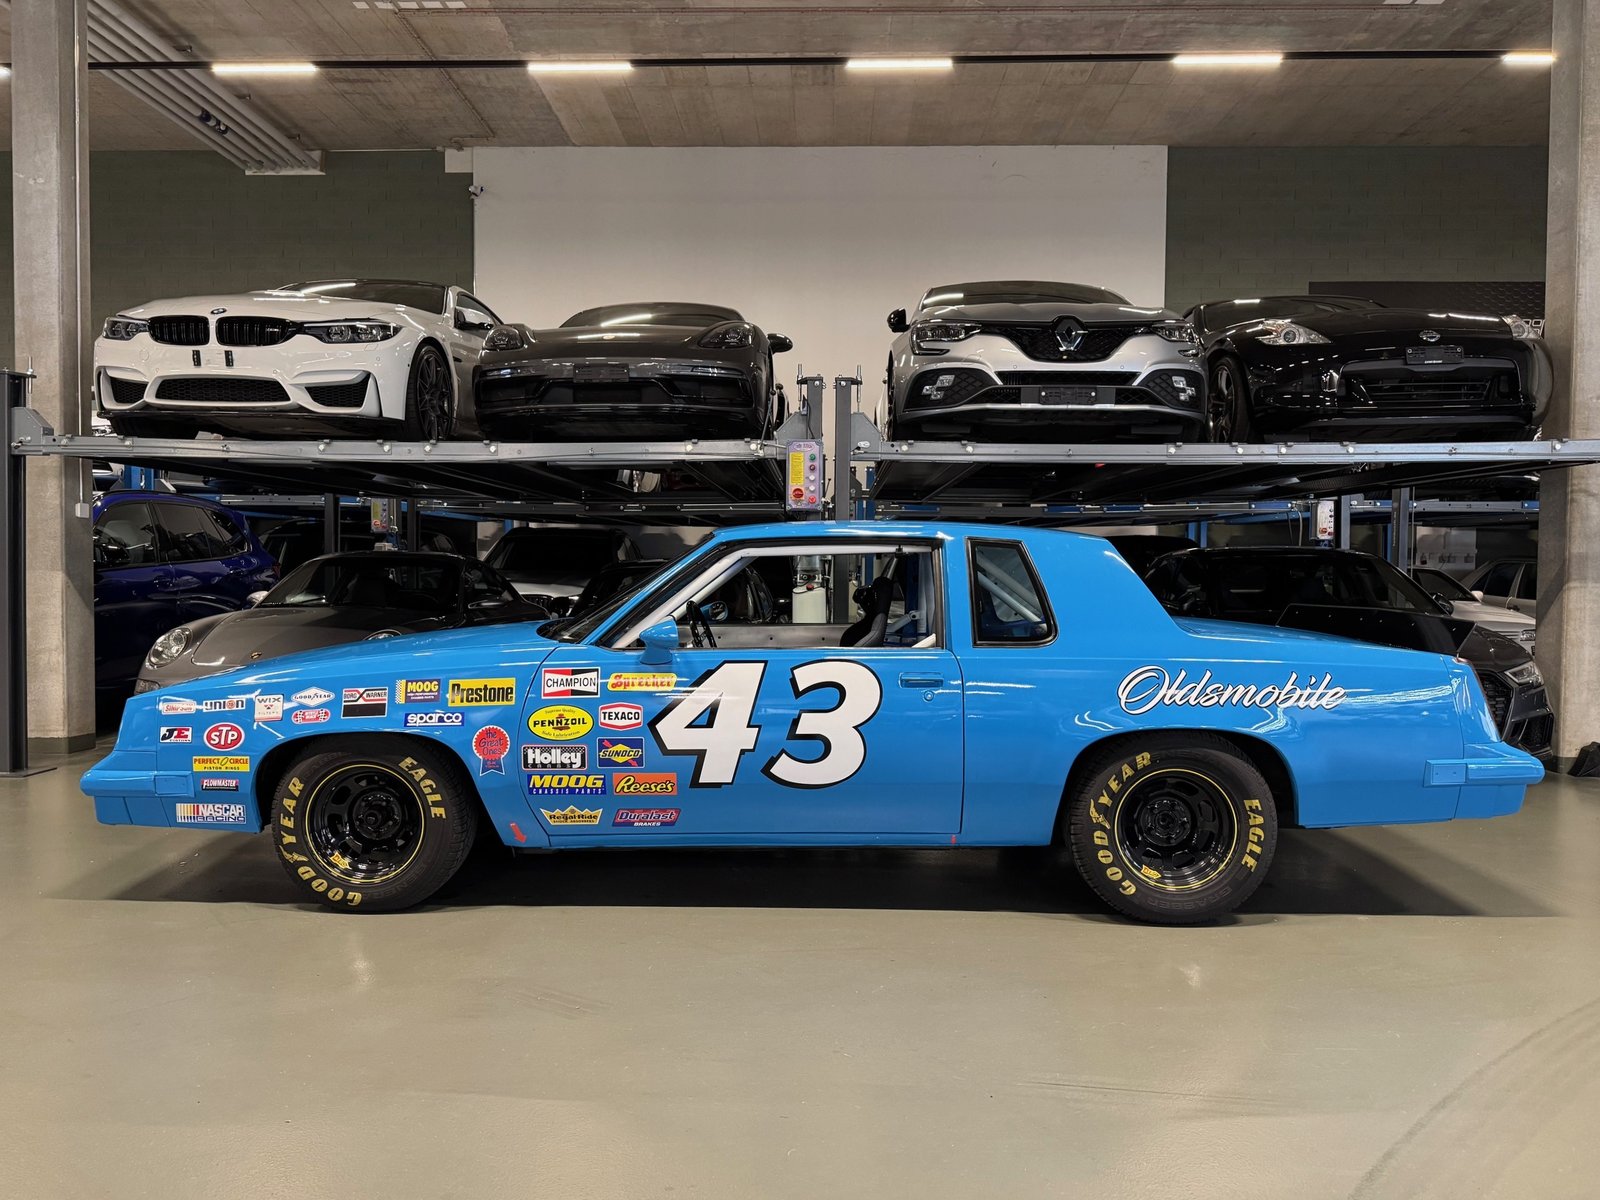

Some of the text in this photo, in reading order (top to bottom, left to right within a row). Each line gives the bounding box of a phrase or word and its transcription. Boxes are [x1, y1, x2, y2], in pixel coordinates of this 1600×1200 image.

[407, 681, 438, 692] MOOG
[545, 677, 597, 688] CHAMPION
[365, 691, 387, 699] WARNER
[451, 683, 514, 703] Prestone
[1117, 665, 1347, 715] Oldsmobile
[407, 713, 462, 727] sparco
[533, 717, 587, 728] PENNZOIL
[602, 711, 640, 721] TEXACO
[647, 659, 883, 790] 43
[160, 729, 190, 742] JE
[210, 726, 239, 746] STP
[527, 748, 582, 769] Holley
[601, 749, 640, 758] SUNOCO
[398, 756, 447, 820] EAGLE
[529, 775, 605, 788] MOOG
[615, 775, 675, 793] Reese's
[575, 787, 603, 795] PARTS
[199, 803, 244, 817] NASCAR
[618, 810, 676, 821] Duralast
[1241, 799, 1265, 873] EAGLE
